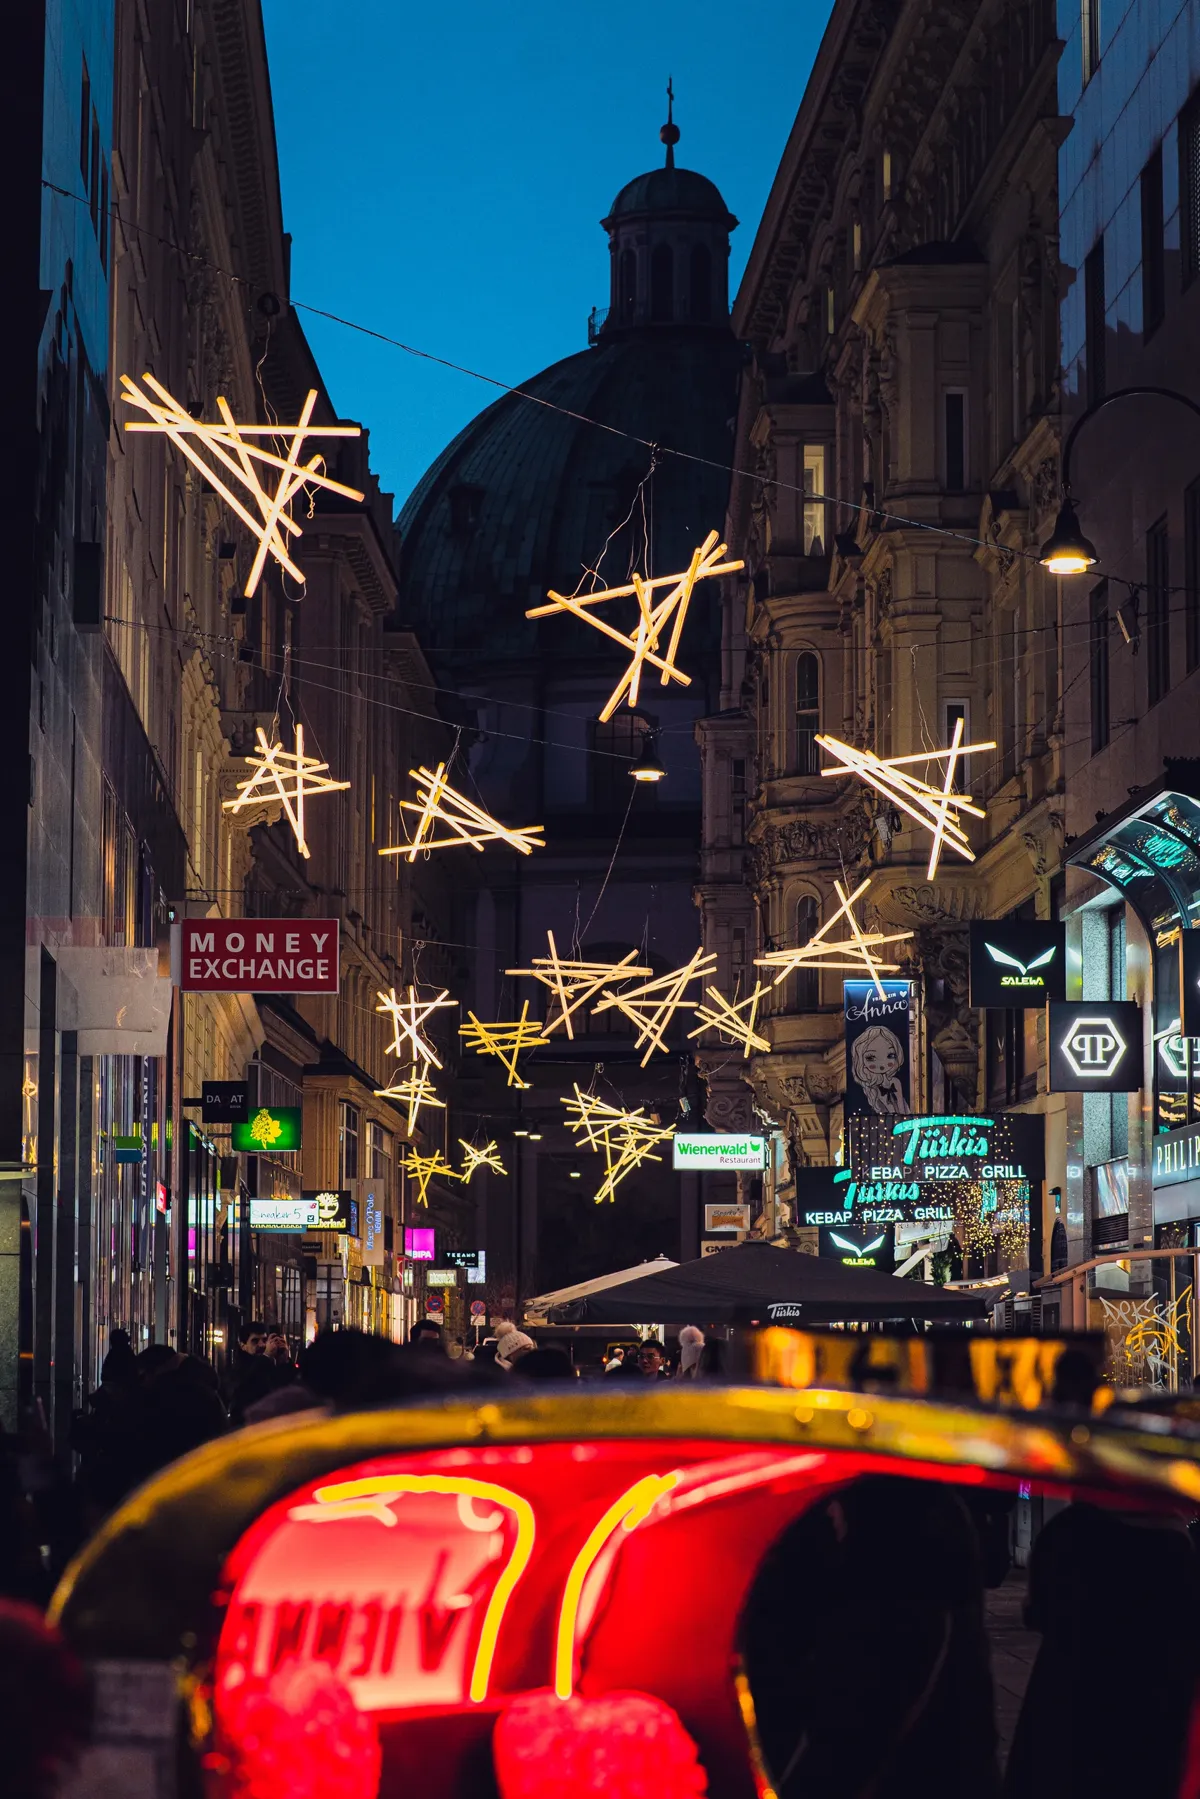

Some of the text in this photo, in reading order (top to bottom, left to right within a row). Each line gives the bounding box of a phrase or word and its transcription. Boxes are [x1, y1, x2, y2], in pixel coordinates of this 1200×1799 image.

[190, 933, 329, 953] MONEY
[189, 958, 329, 979] EXCHANGE
[1000, 976, 1044, 986] SALEWA
[846, 988, 908, 1022] Anna
[893, 1116, 995, 1165] Türkis
[677, 1142, 748, 1155] Wienerwald
[719, 1156, 761, 1164] Restaurant
[861, 1165, 1026, 1180] KEBAP PIZZA GRILL
[293, 1207, 302, 1219] 5
[805, 1206, 955, 1224] KEBAP PIZZA GRILL
[412, 1250, 433, 1259] BIPA
[842, 1258, 876, 1266] SALEWA
[767, 1302, 802, 1320] Türkis
